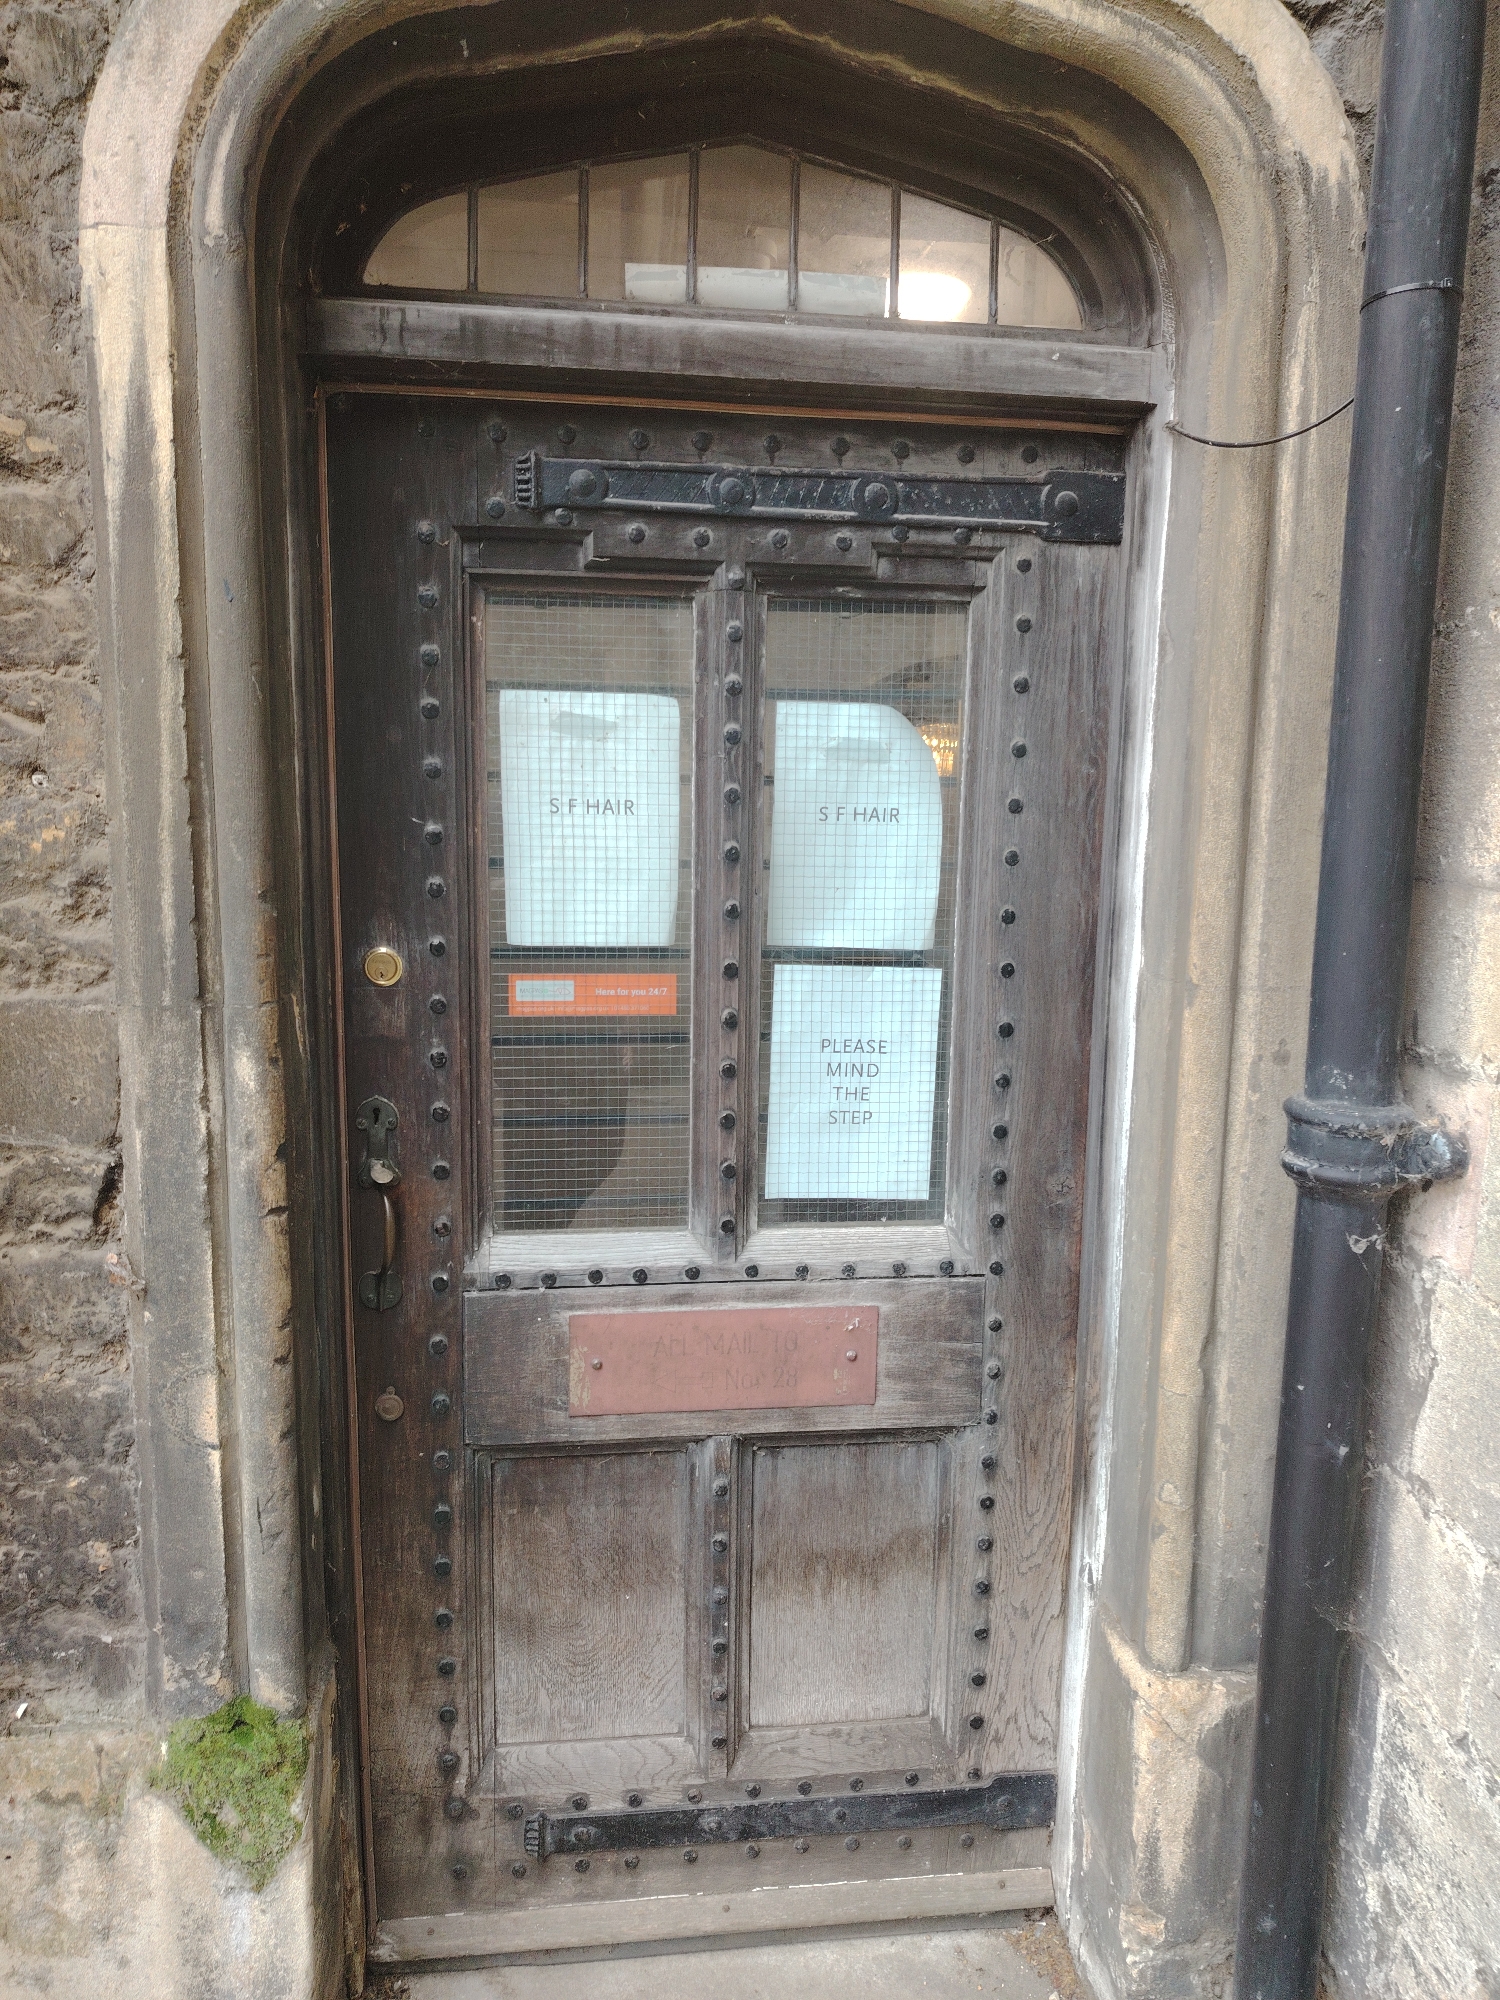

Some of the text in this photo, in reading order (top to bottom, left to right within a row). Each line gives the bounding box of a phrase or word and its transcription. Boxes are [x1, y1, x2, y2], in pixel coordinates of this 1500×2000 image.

[549, 797, 635, 816] S F HAIR
[818, 806, 900, 823] S F HAIR
[595, 987, 668, 998] Here for you 24/7
[821, 1038, 888, 1055] PLEASE
[826, 1062, 879, 1078] MIND
[832, 1086, 870, 1101] THE
[828, 1110, 873, 1125] STEP
[705, 1330, 760, 1355] MAIL
[773, 1366, 798, 1389] 28
